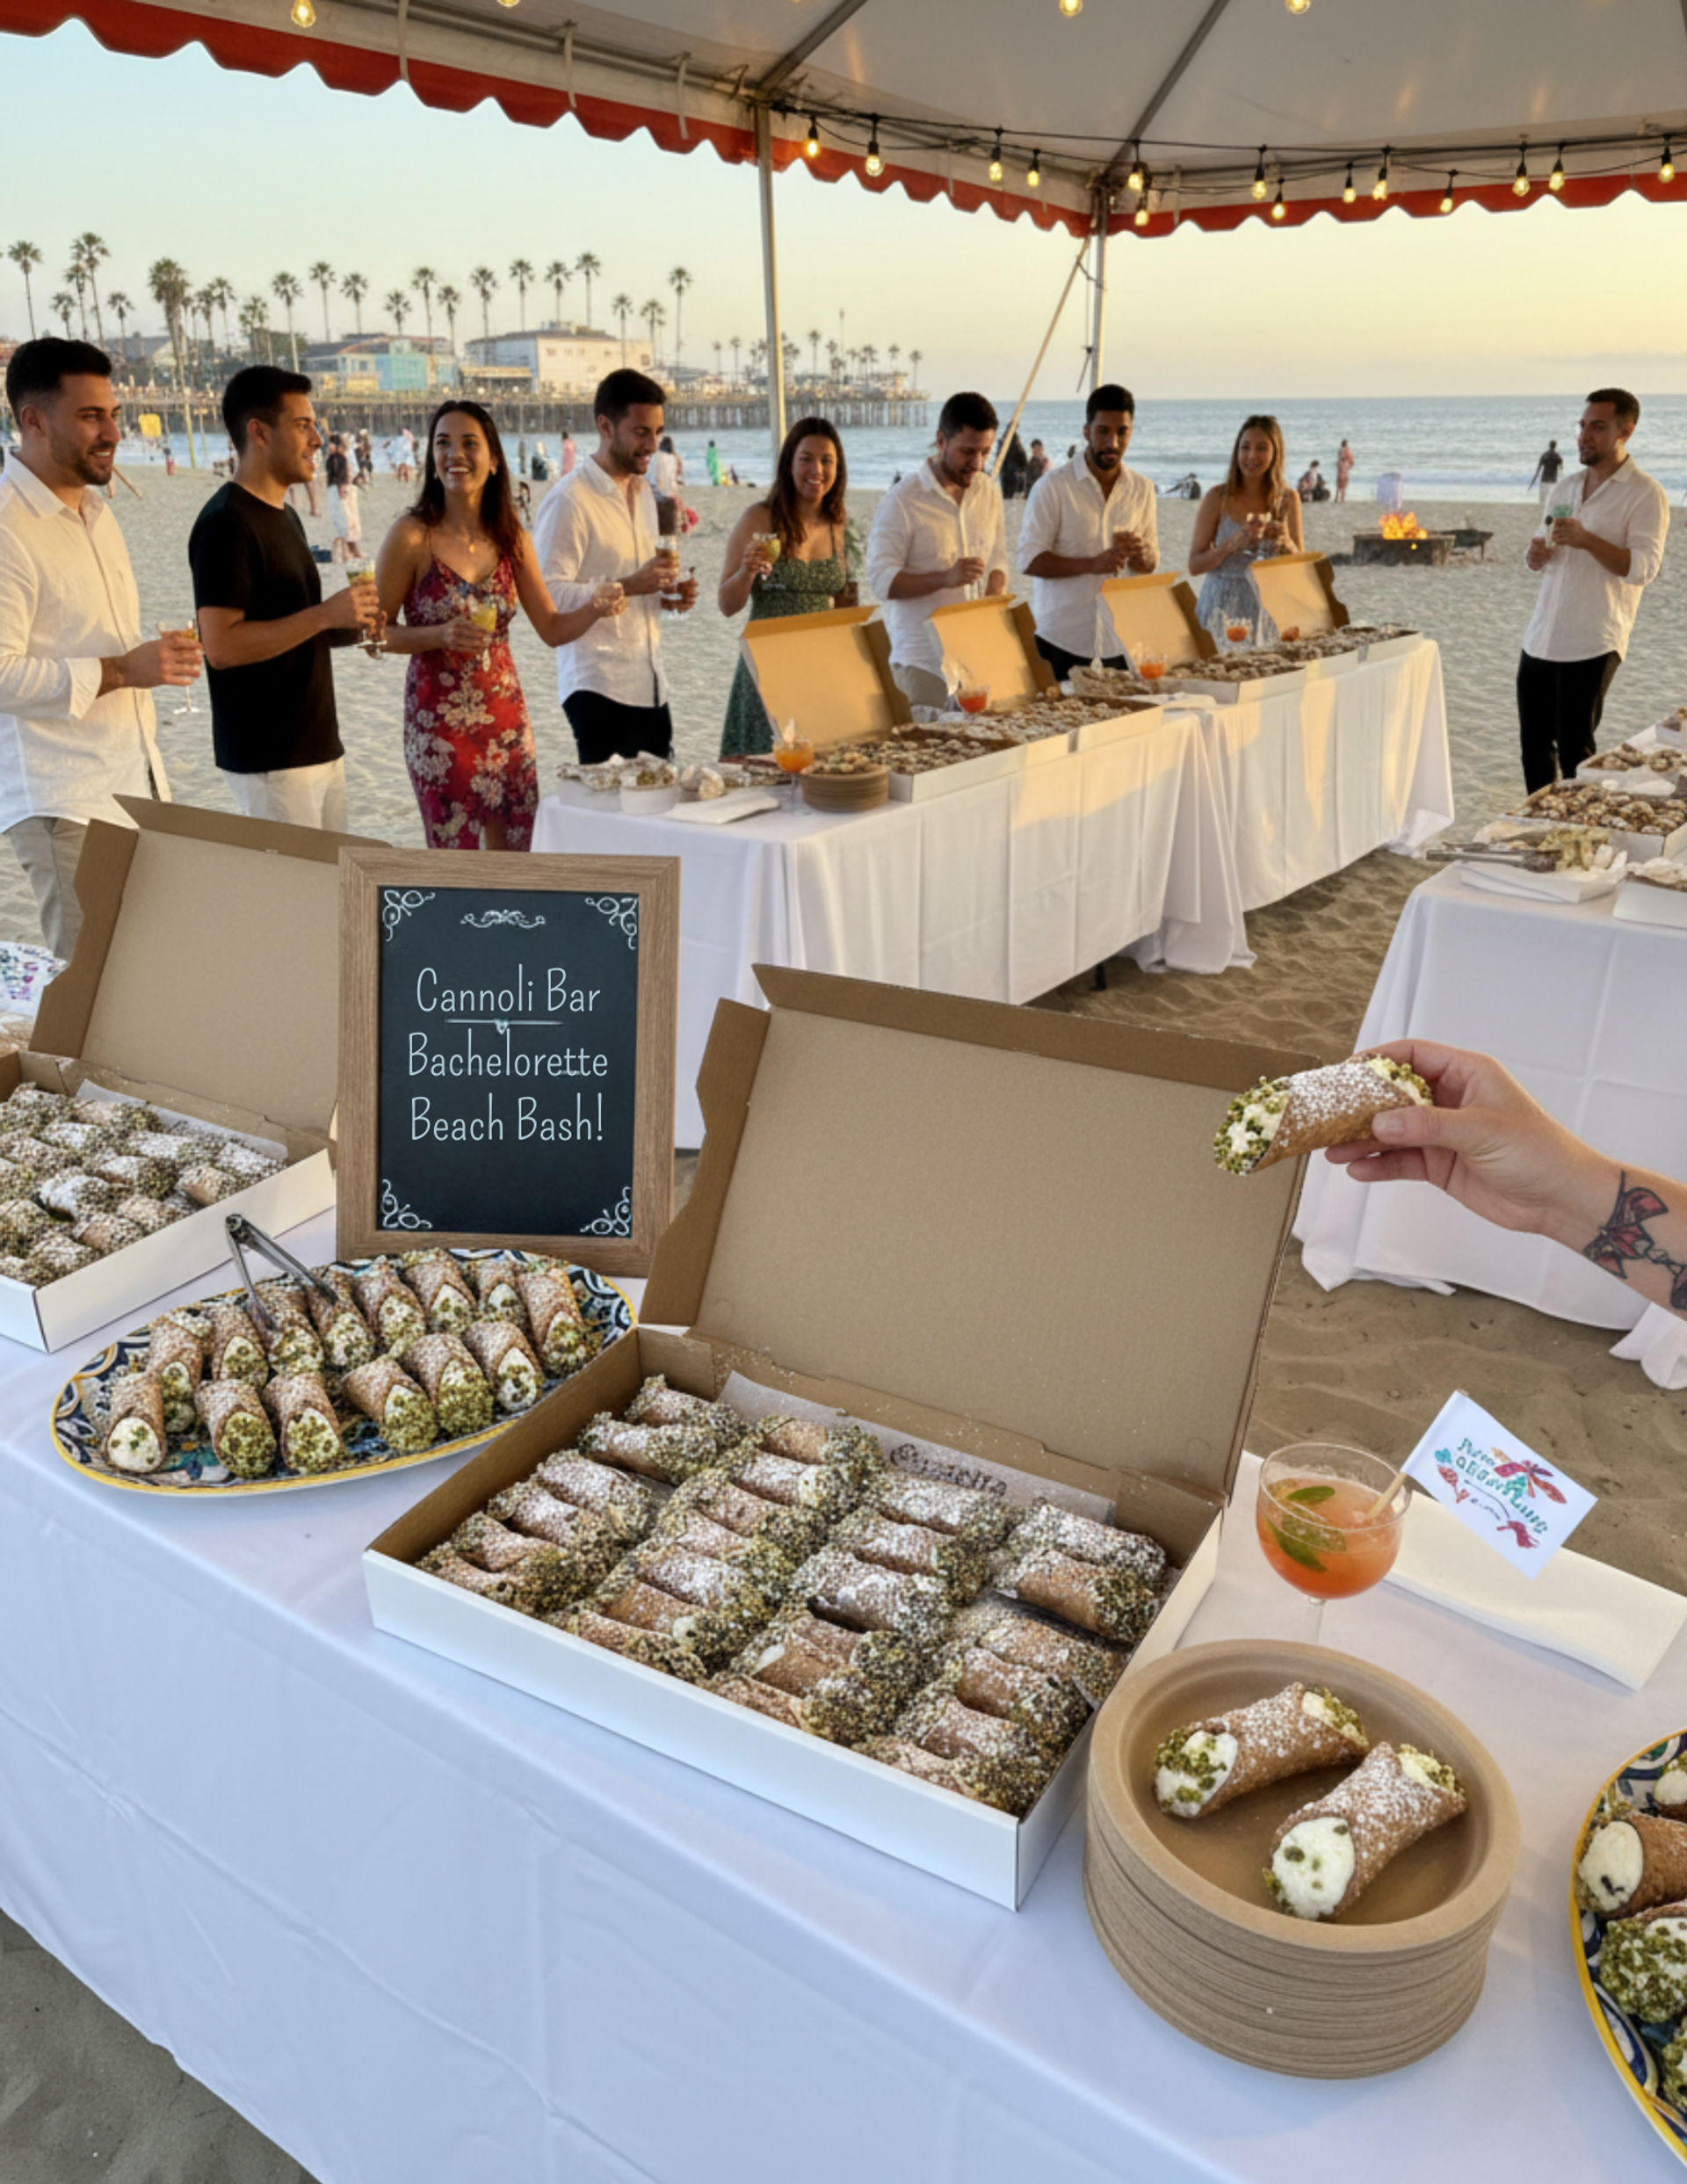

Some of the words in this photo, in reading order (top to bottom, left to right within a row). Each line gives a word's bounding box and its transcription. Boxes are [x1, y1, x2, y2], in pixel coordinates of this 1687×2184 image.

[416, 962, 533, 1012] Cannoli
[547, 967, 601, 1012] Bar
[408, 1027, 608, 1077] Bachelorette
[411, 1092, 503, 1142] Beach
[518, 1092, 603, 1142] Bash!
